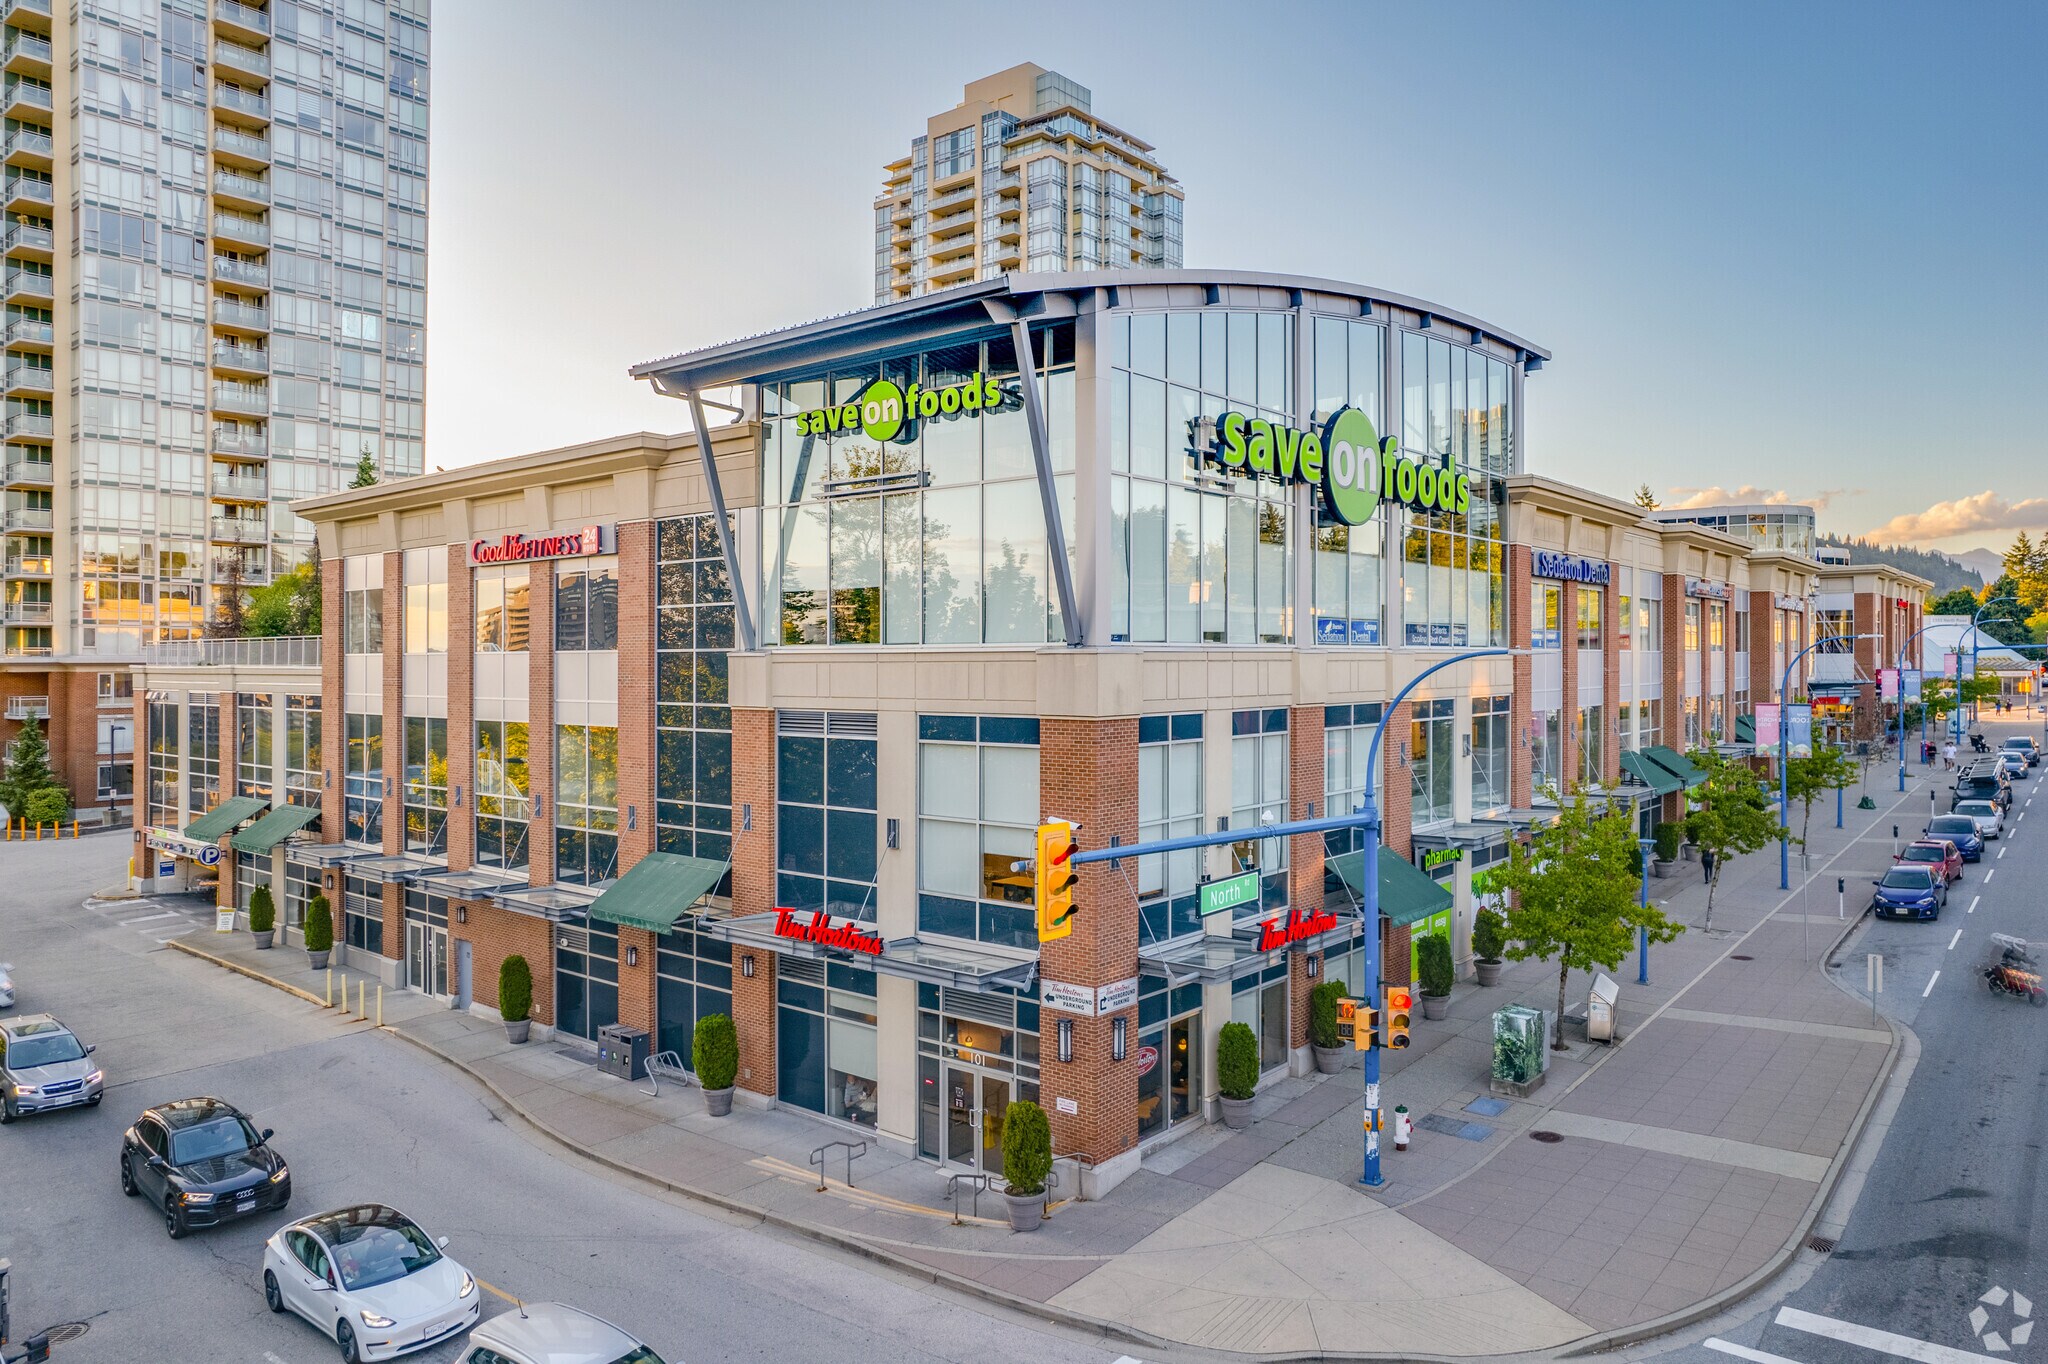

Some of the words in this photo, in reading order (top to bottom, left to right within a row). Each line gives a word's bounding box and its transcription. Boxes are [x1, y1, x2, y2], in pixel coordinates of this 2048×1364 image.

[797, 404, 858, 437] save
[864, 397, 899, 426] on
[906, 372, 1002, 420] foods
[1220, 411, 1323, 485] save
[1332, 440, 1377, 494] on
[1383, 435, 1470, 515] foods
[584, 529, 596, 544] 24
[1539, 552, 1583, 582] Sedation
[1319, 630, 1345, 642] Sedation
[1352, 631, 1370, 643] Dental
[205, 848, 218, 862] P
[1425, 848, 1464, 871] pharmacy
[1210, 886, 1241, 907] North
[1244, 878, 1250, 887] Rd
[771, 907, 807, 941] Tim
[808, 911, 883, 955] Hortons
[1259, 917, 1287, 952] Tim
[1286, 908, 1337, 943] Hortons
[1052, 983, 1062, 992] Tim
[1062, 986, 1084, 997] Hortons
[1107, 989, 1135, 1002] UNDERGROUND
[1055, 994, 1092, 1006] UNDERGROUND
[1063, 1002, 1085, 1010] PARKING
[1113, 997, 1130, 1006] PARKING
[970, 1052, 985, 1067] 101
